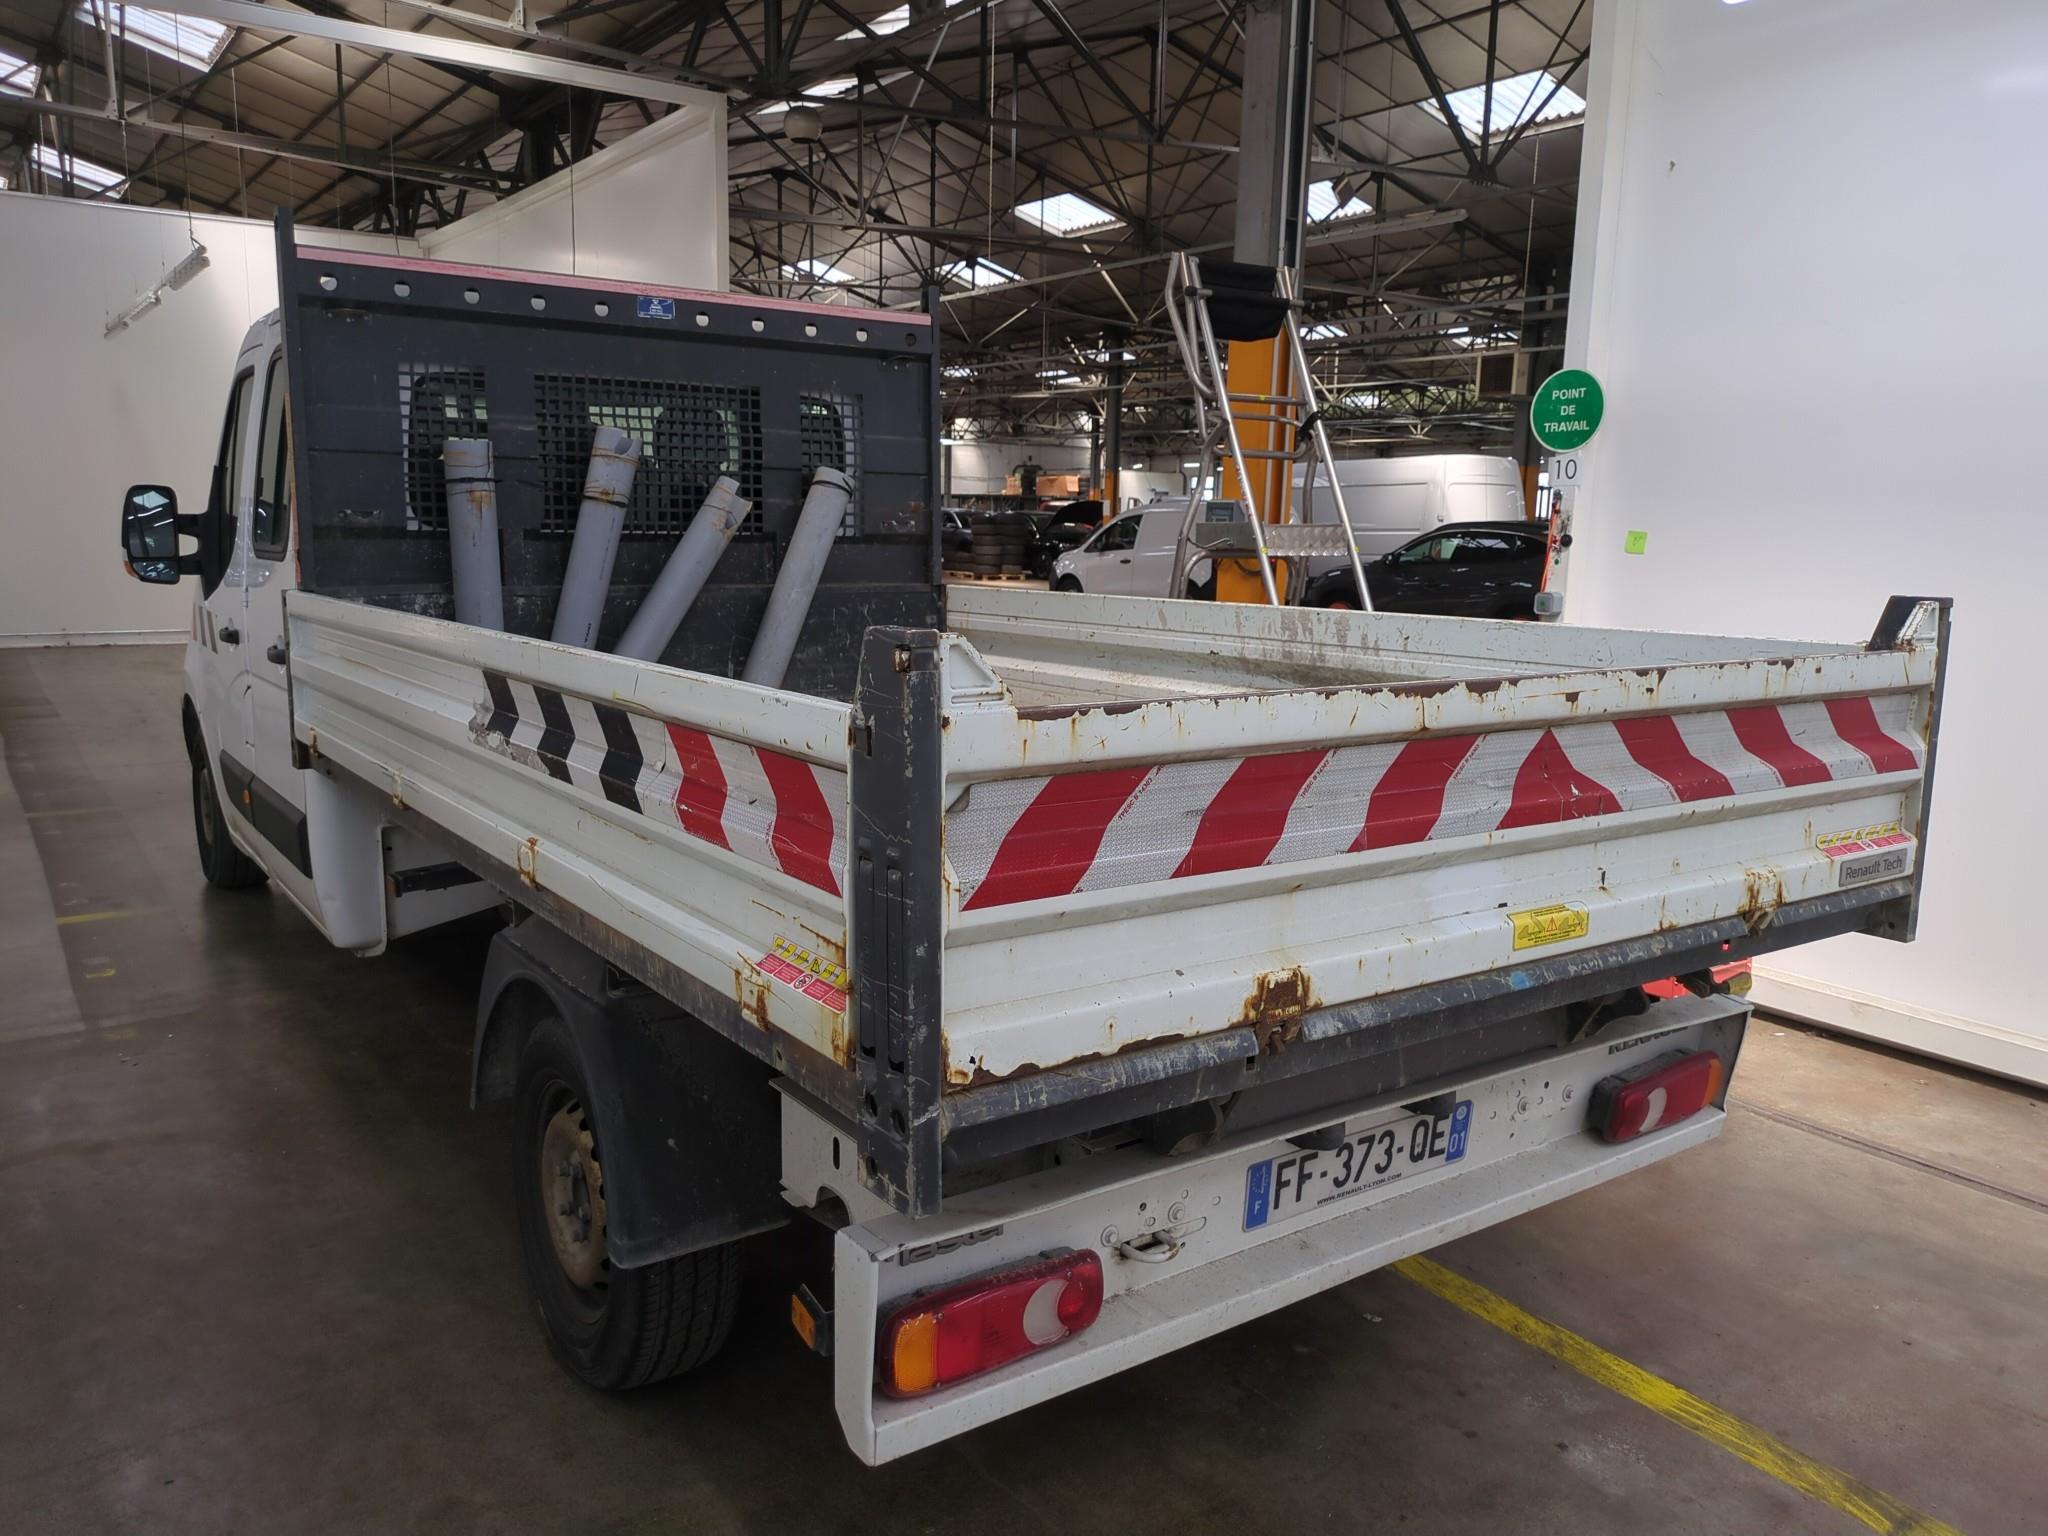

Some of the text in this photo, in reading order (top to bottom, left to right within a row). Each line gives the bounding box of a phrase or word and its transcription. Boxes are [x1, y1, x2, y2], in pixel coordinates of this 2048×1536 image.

[1551, 387, 1587, 401] POINT
[1560, 404, 1577, 416] DE
[1543, 420, 1590, 433] TRAVAIL
[1555, 459, 1577, 480] 10
[1845, 855, 1903, 881] Renault Tech
[1449, 1131, 1465, 1153] 01
[1273, 1114, 1450, 1210] FF-373-QE
[1316, 1172, 1403, 1206] WWW.RENAULT-LYON.COM
[1254, 1200, 1262, 1215] F
